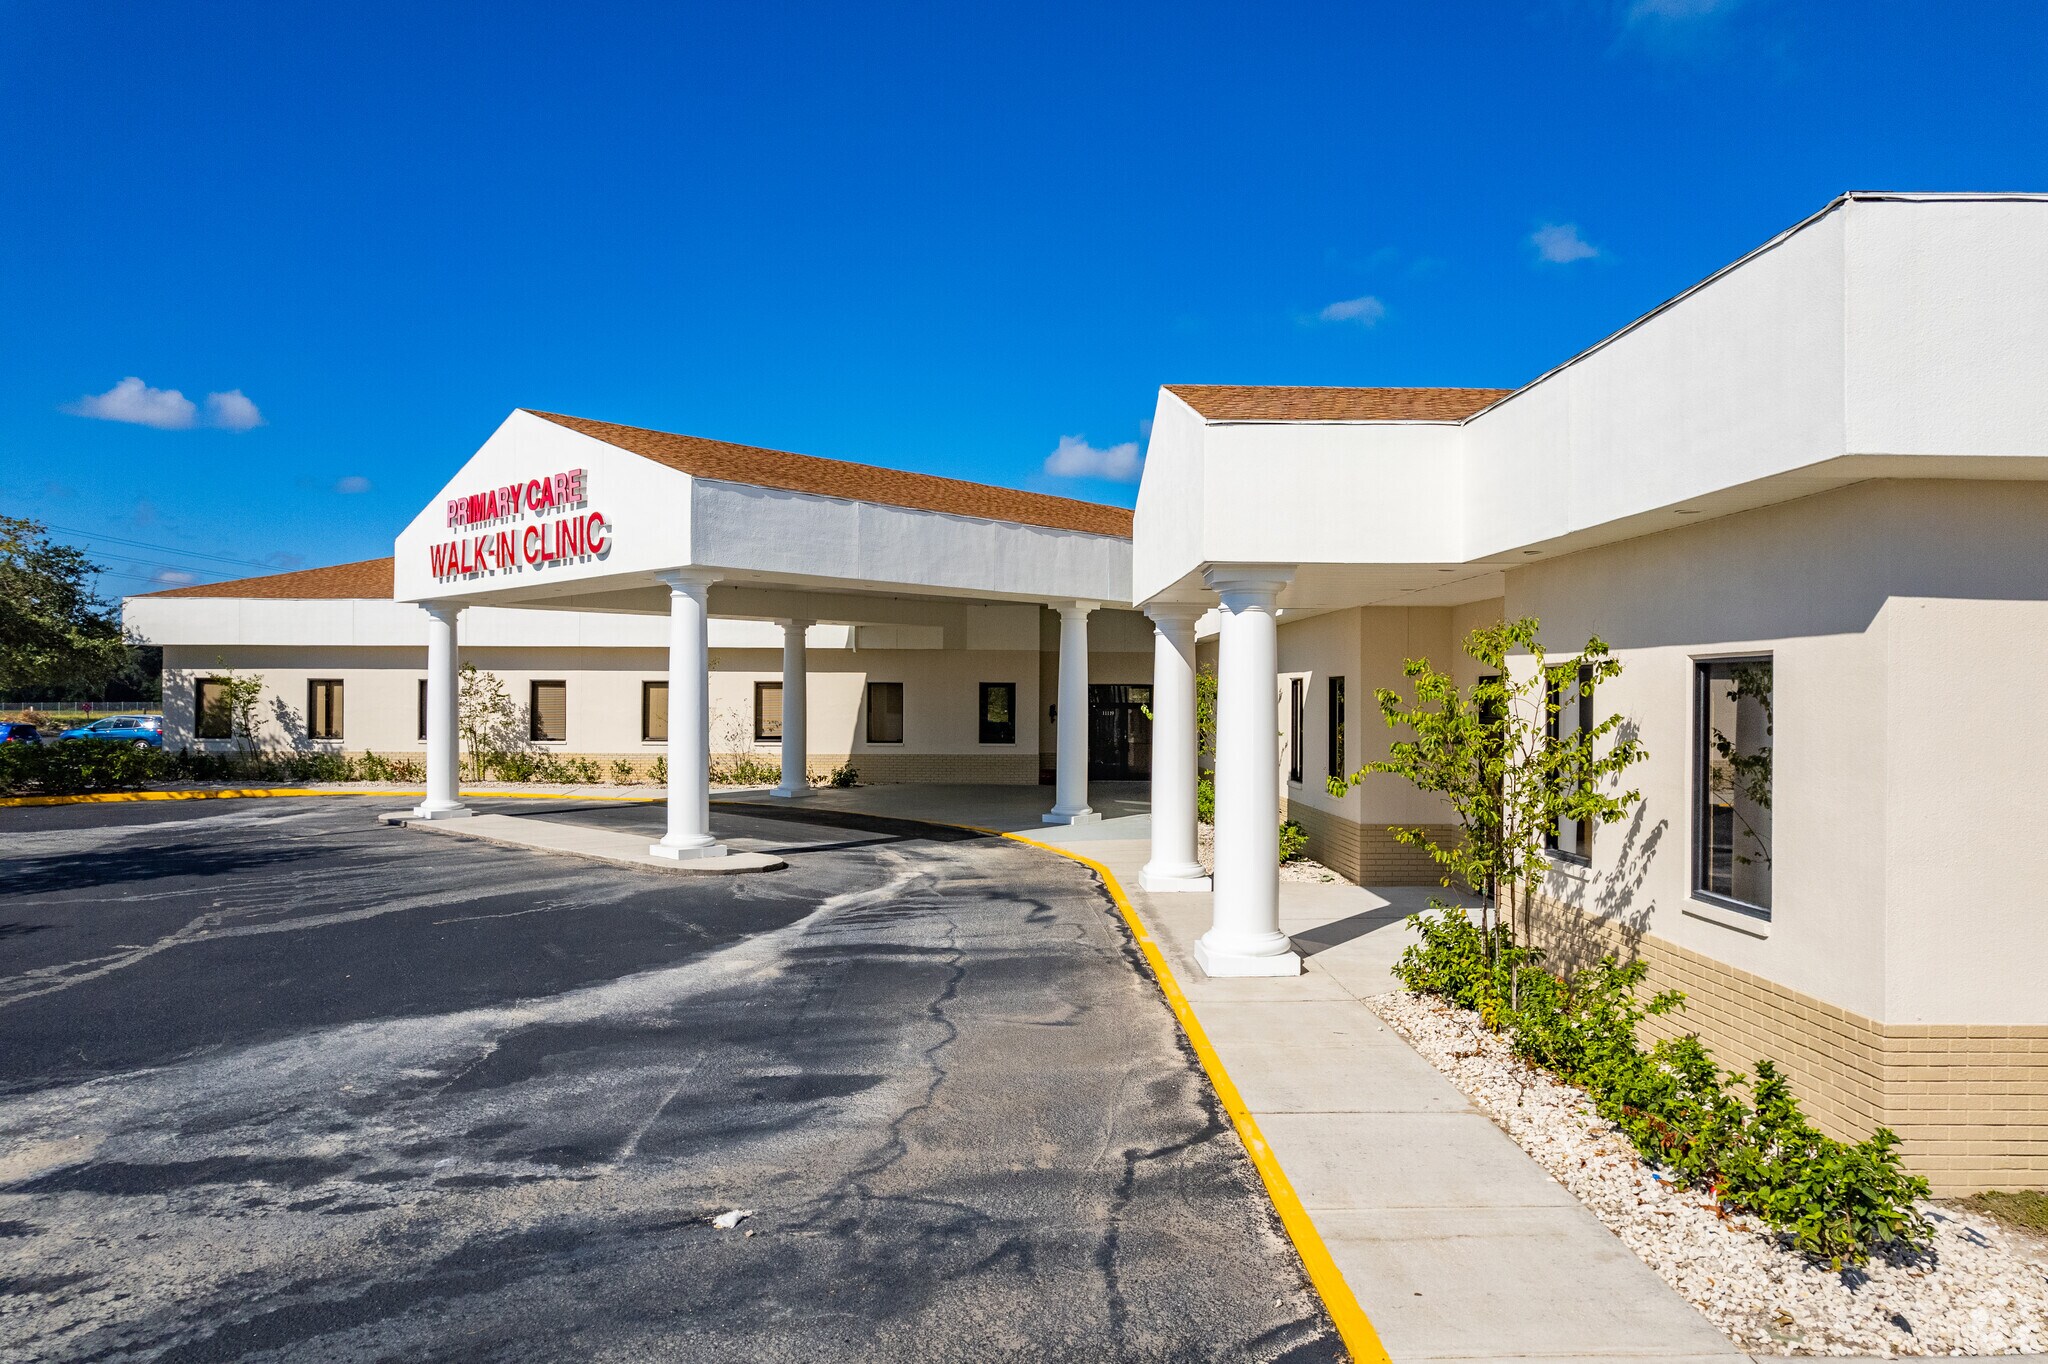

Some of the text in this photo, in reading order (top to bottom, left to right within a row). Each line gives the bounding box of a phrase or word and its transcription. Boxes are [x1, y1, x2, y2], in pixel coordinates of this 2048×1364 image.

[447, 468, 583, 528] PRIMARY CARE
[430, 511, 606, 578] WALK-IN CLINIC
